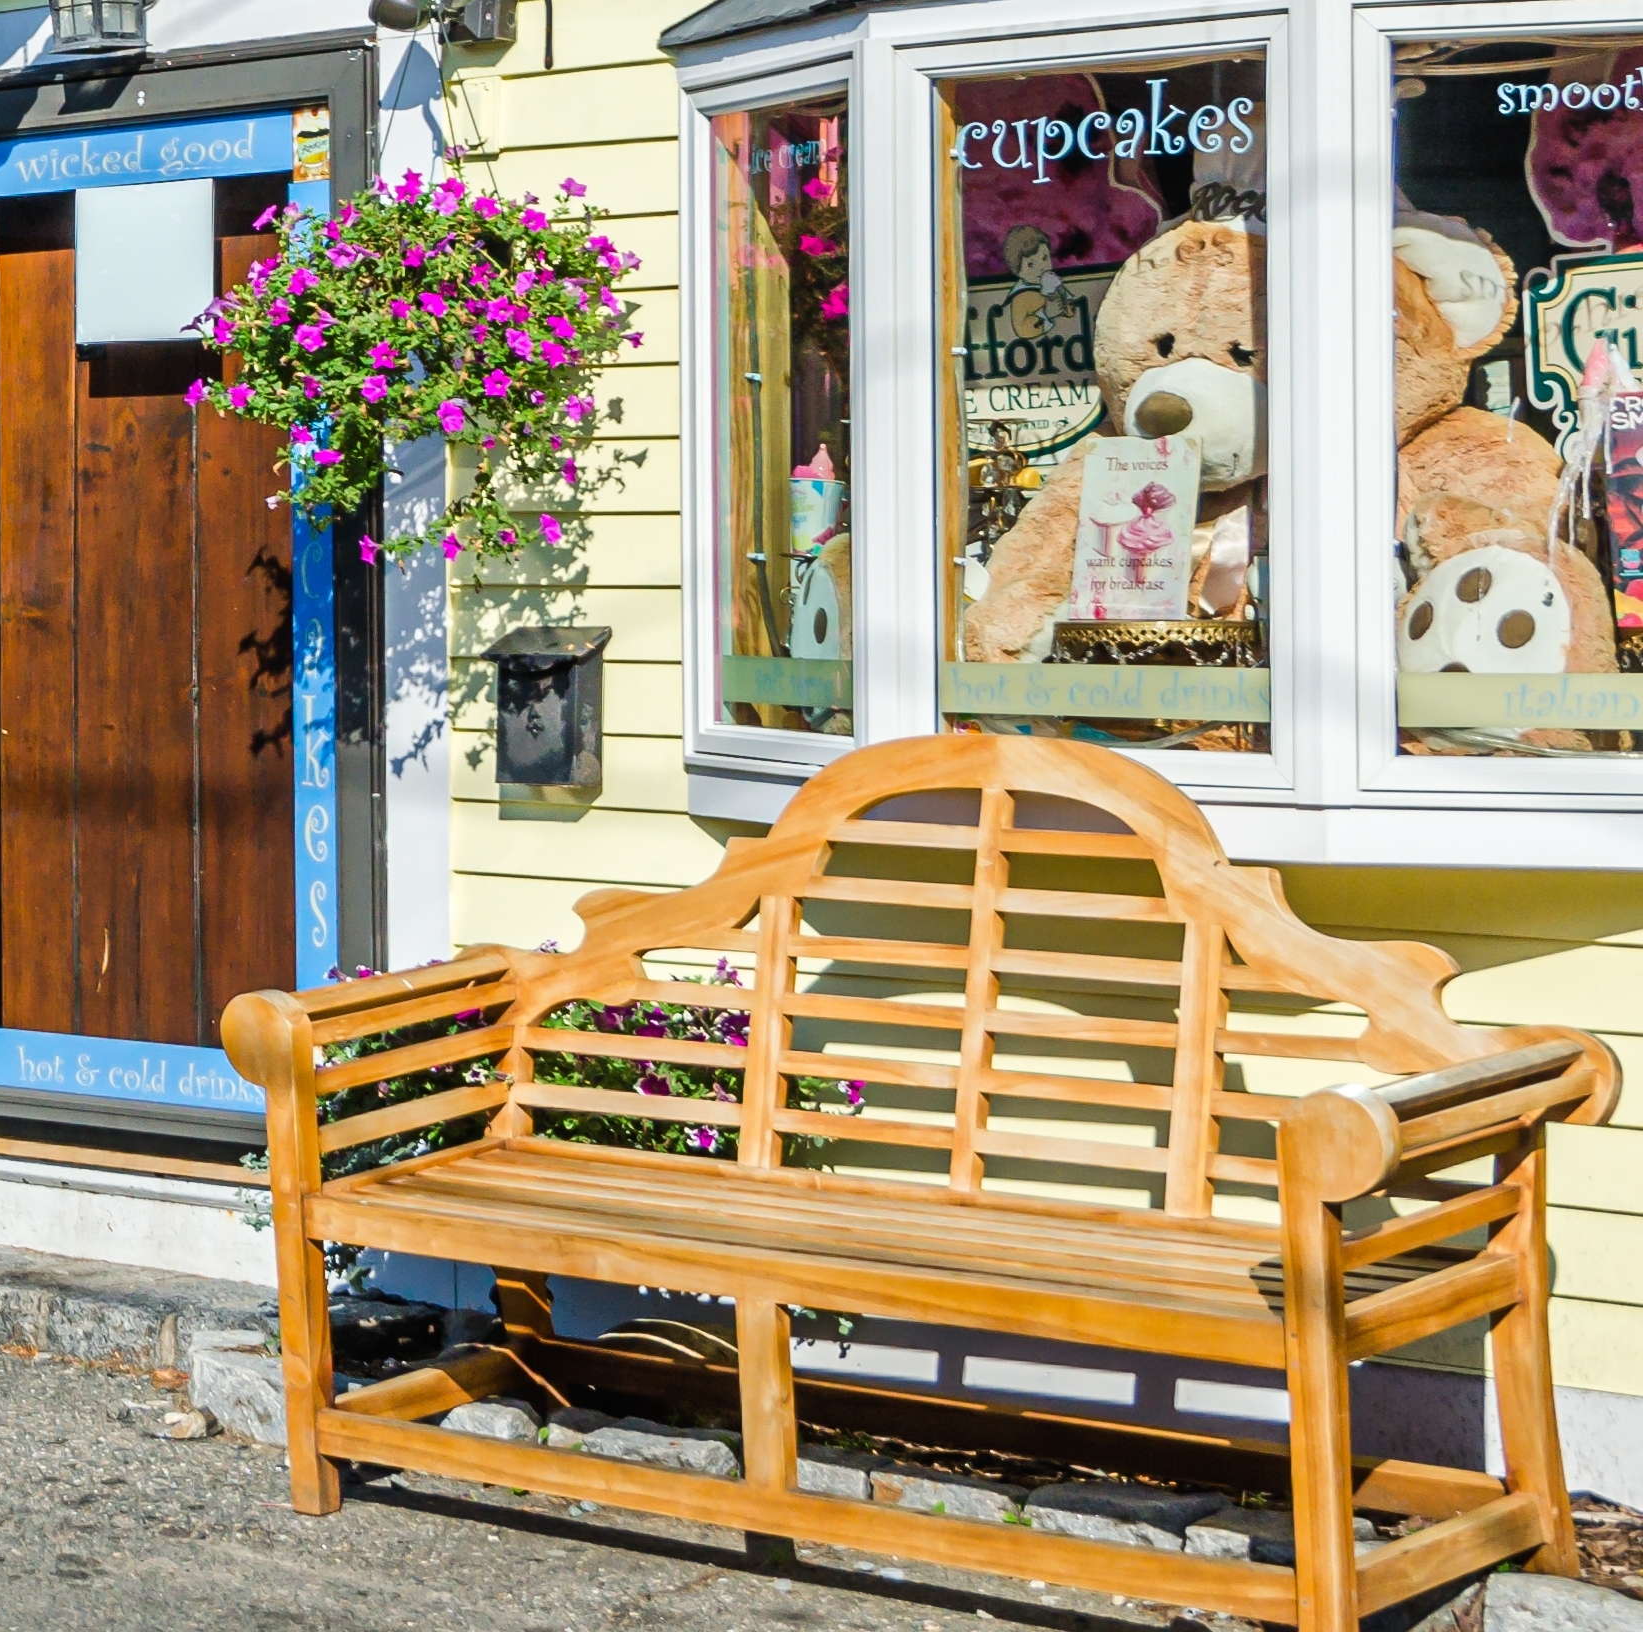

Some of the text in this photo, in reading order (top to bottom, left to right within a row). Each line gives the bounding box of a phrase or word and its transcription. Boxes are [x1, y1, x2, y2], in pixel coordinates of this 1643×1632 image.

[15, 121, 256, 184] wicked good
[955, 78, 1255, 184] cupcakes
[965, 295, 1094, 380] fford
[988, 378, 1092, 413] CREAM
[1106, 457, 1169, 471] The voices
[1086, 555, 1173, 571] want cupcakes
[1090, 575, 1165, 592] for breakfast
[951, 667, 1011, 710] hot
[1068, 669, 1145, 709] cold
[17, 1045, 64, 1084] hot
[75, 1053, 100, 1087] &
[108, 1057, 166, 1094] cold
